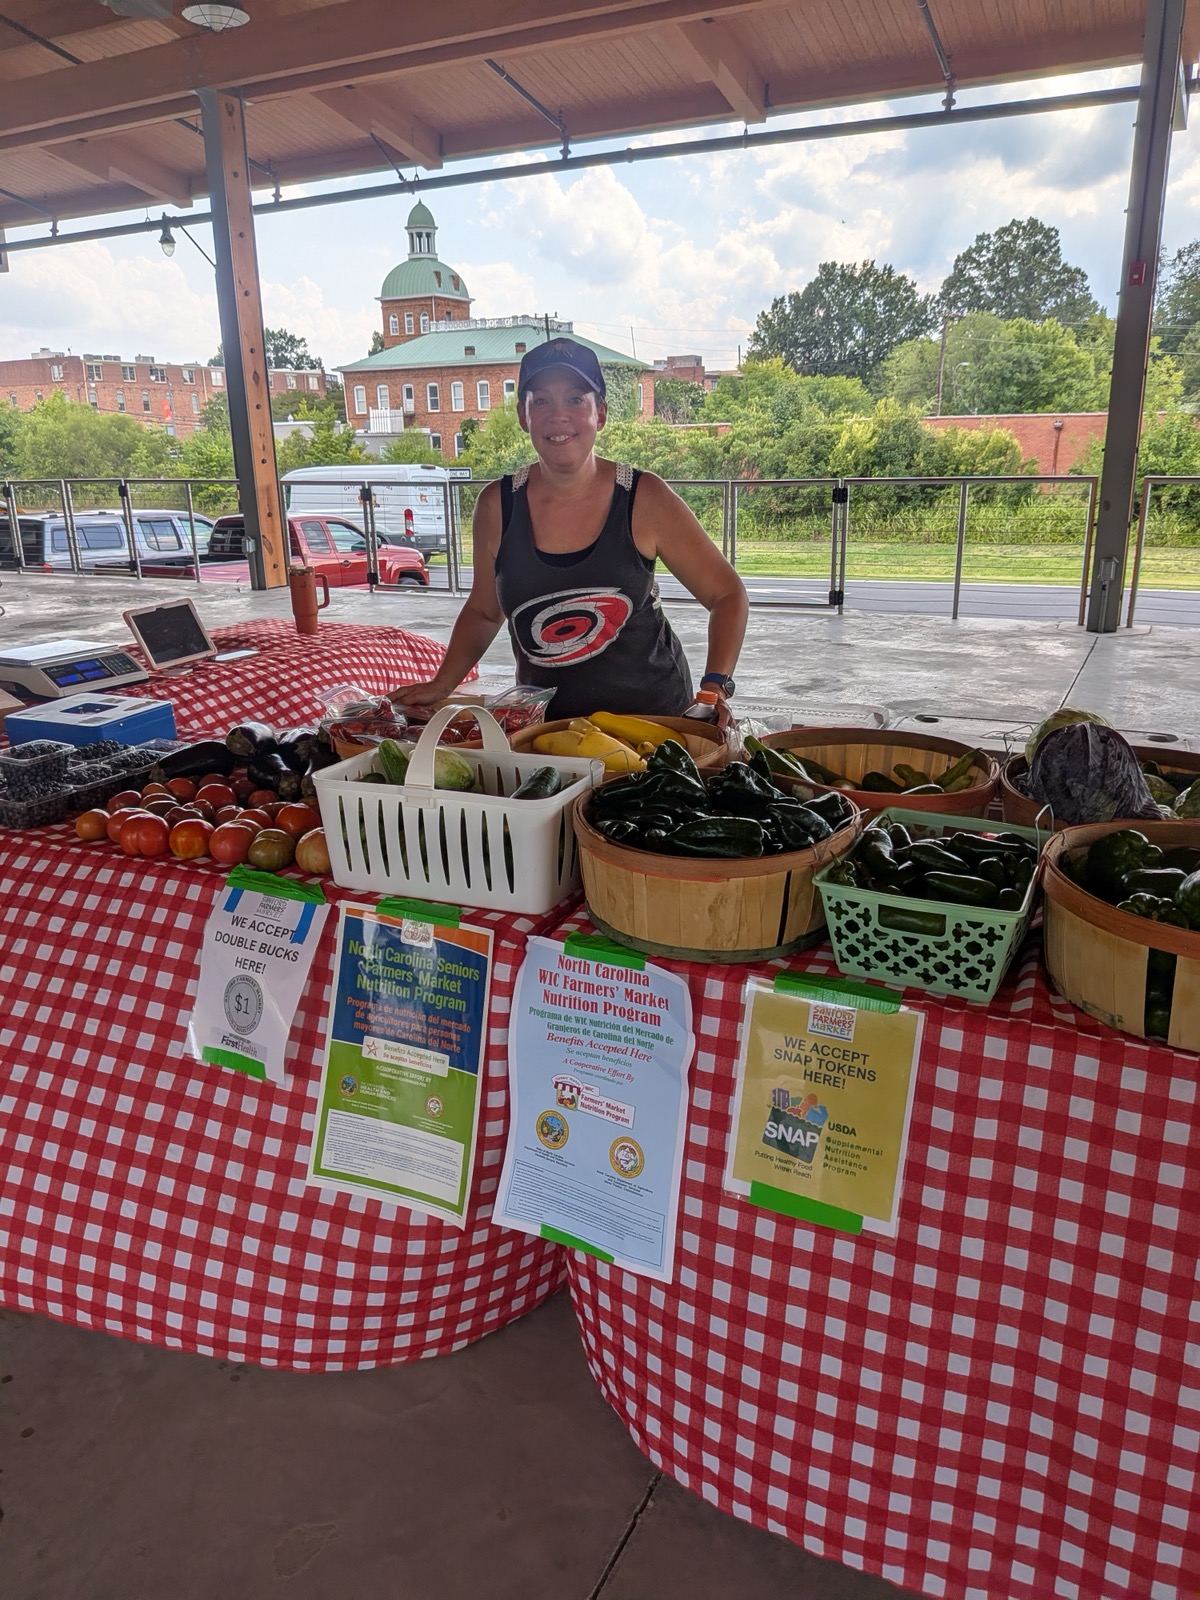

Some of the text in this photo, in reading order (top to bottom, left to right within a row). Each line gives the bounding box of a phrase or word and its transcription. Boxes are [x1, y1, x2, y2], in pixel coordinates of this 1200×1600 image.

[231, 915, 296, 940] WE ACCEPT
[215, 931, 299, 962] DOUBLE BUCKS
[235, 957, 266, 974] HERE!
[348, 940, 480, 981] North Carolina Seniors
[557, 954, 650, 987] North Carolina
[366, 959, 462, 994] Farmers' Market
[356, 974, 467, 1012] Nutrition Program
[538, 968, 669, 1011] WIC Farmers' Market
[234, 993, 250, 1015] $1
[346, 997, 382, 1012] Programa
[384, 1005, 393, 1014] de
[428, 1014, 439, 1024] del
[440, 1018, 471, 1033] mercado
[542, 989, 662, 1027] Nutrition Program
[355, 1010, 365, 1019] de
[367, 1013, 410, 1029] agricultores
[410, 1024, 427, 1033] para
[528, 1006, 674, 1046] Programa de WIC Nutrición del Mercado de
[386, 1027, 395, 1036] de
[396, 1030, 426, 1043] Carolina
[427, 1037, 439, 1048] del
[440, 1041, 461, 1053] Norte
[546, 1032, 653, 1063] Benefits Accepted Here
[547, 1022, 655, 1051] Granjeros de Carolina del Norte
[384, 1043, 446, 1065] Benefits Accepted Here
[575, 1051, 601, 1060] aceptan
[602, 1055, 632, 1068] beneficios
[785, 1036, 870, 1065] WE ACCEPT
[569, 1058, 606, 1074] Cooperative
[607, 1067, 625, 1078] Effort
[626, 1073, 636, 1083] By
[774, 1048, 876, 1082] SNAP TOKENS
[803, 1069, 846, 1089] HERE!
[580, 1102, 630, 1124] Nutrition Program
[581, 1094, 626, 1114] Farmers' Market
[764, 1121, 820, 1148] SNAP
[828, 1121, 857, 1137] USDA
[825, 1145, 860, 1159] Nutrition
[826, 1136, 883, 1156] Supplemental
[754, 1150, 813, 1171] Putting Healthy Food
[774, 1164, 812, 1179] Within Reach
[823, 1162, 857, 1177] Program
[824, 1154, 868, 1171] Assistance
